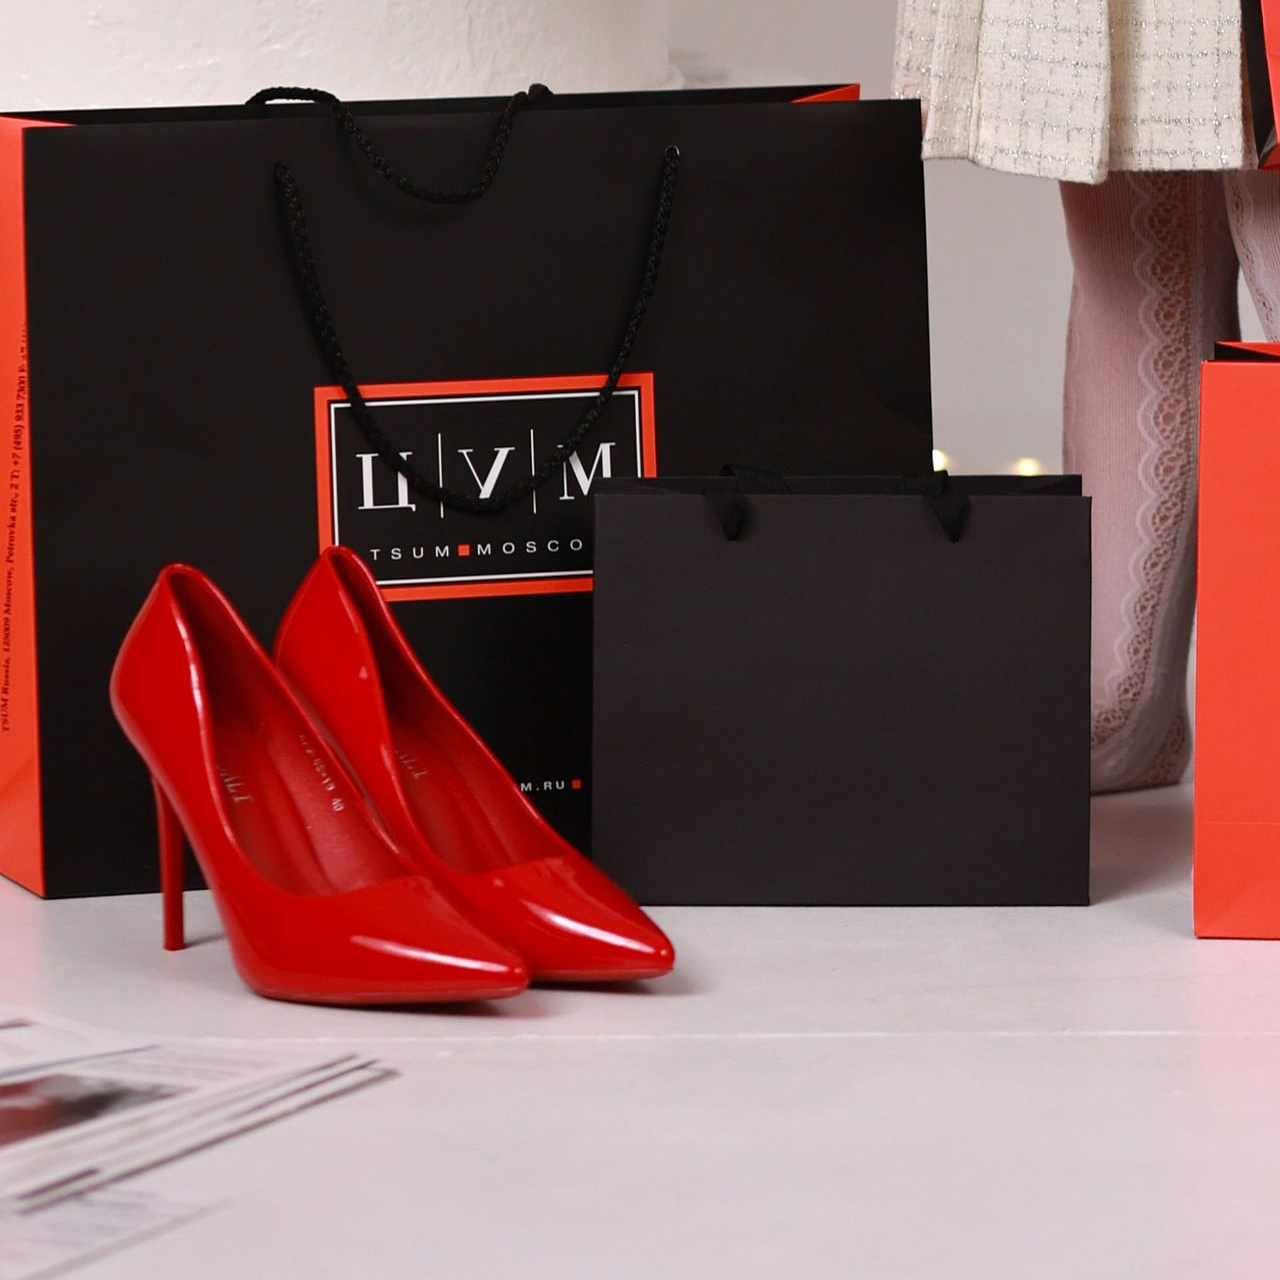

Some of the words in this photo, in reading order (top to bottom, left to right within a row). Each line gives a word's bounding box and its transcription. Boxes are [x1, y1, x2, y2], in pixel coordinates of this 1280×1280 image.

[14, 403, 25, 422] 933
[12, 424, 25, 450] (495)
[11, 452, 21, 467] +7
[5, 516, 17, 564] Petrovka
[371, 545, 450, 561] TSUM
[477, 539, 583, 556] MOSCO
